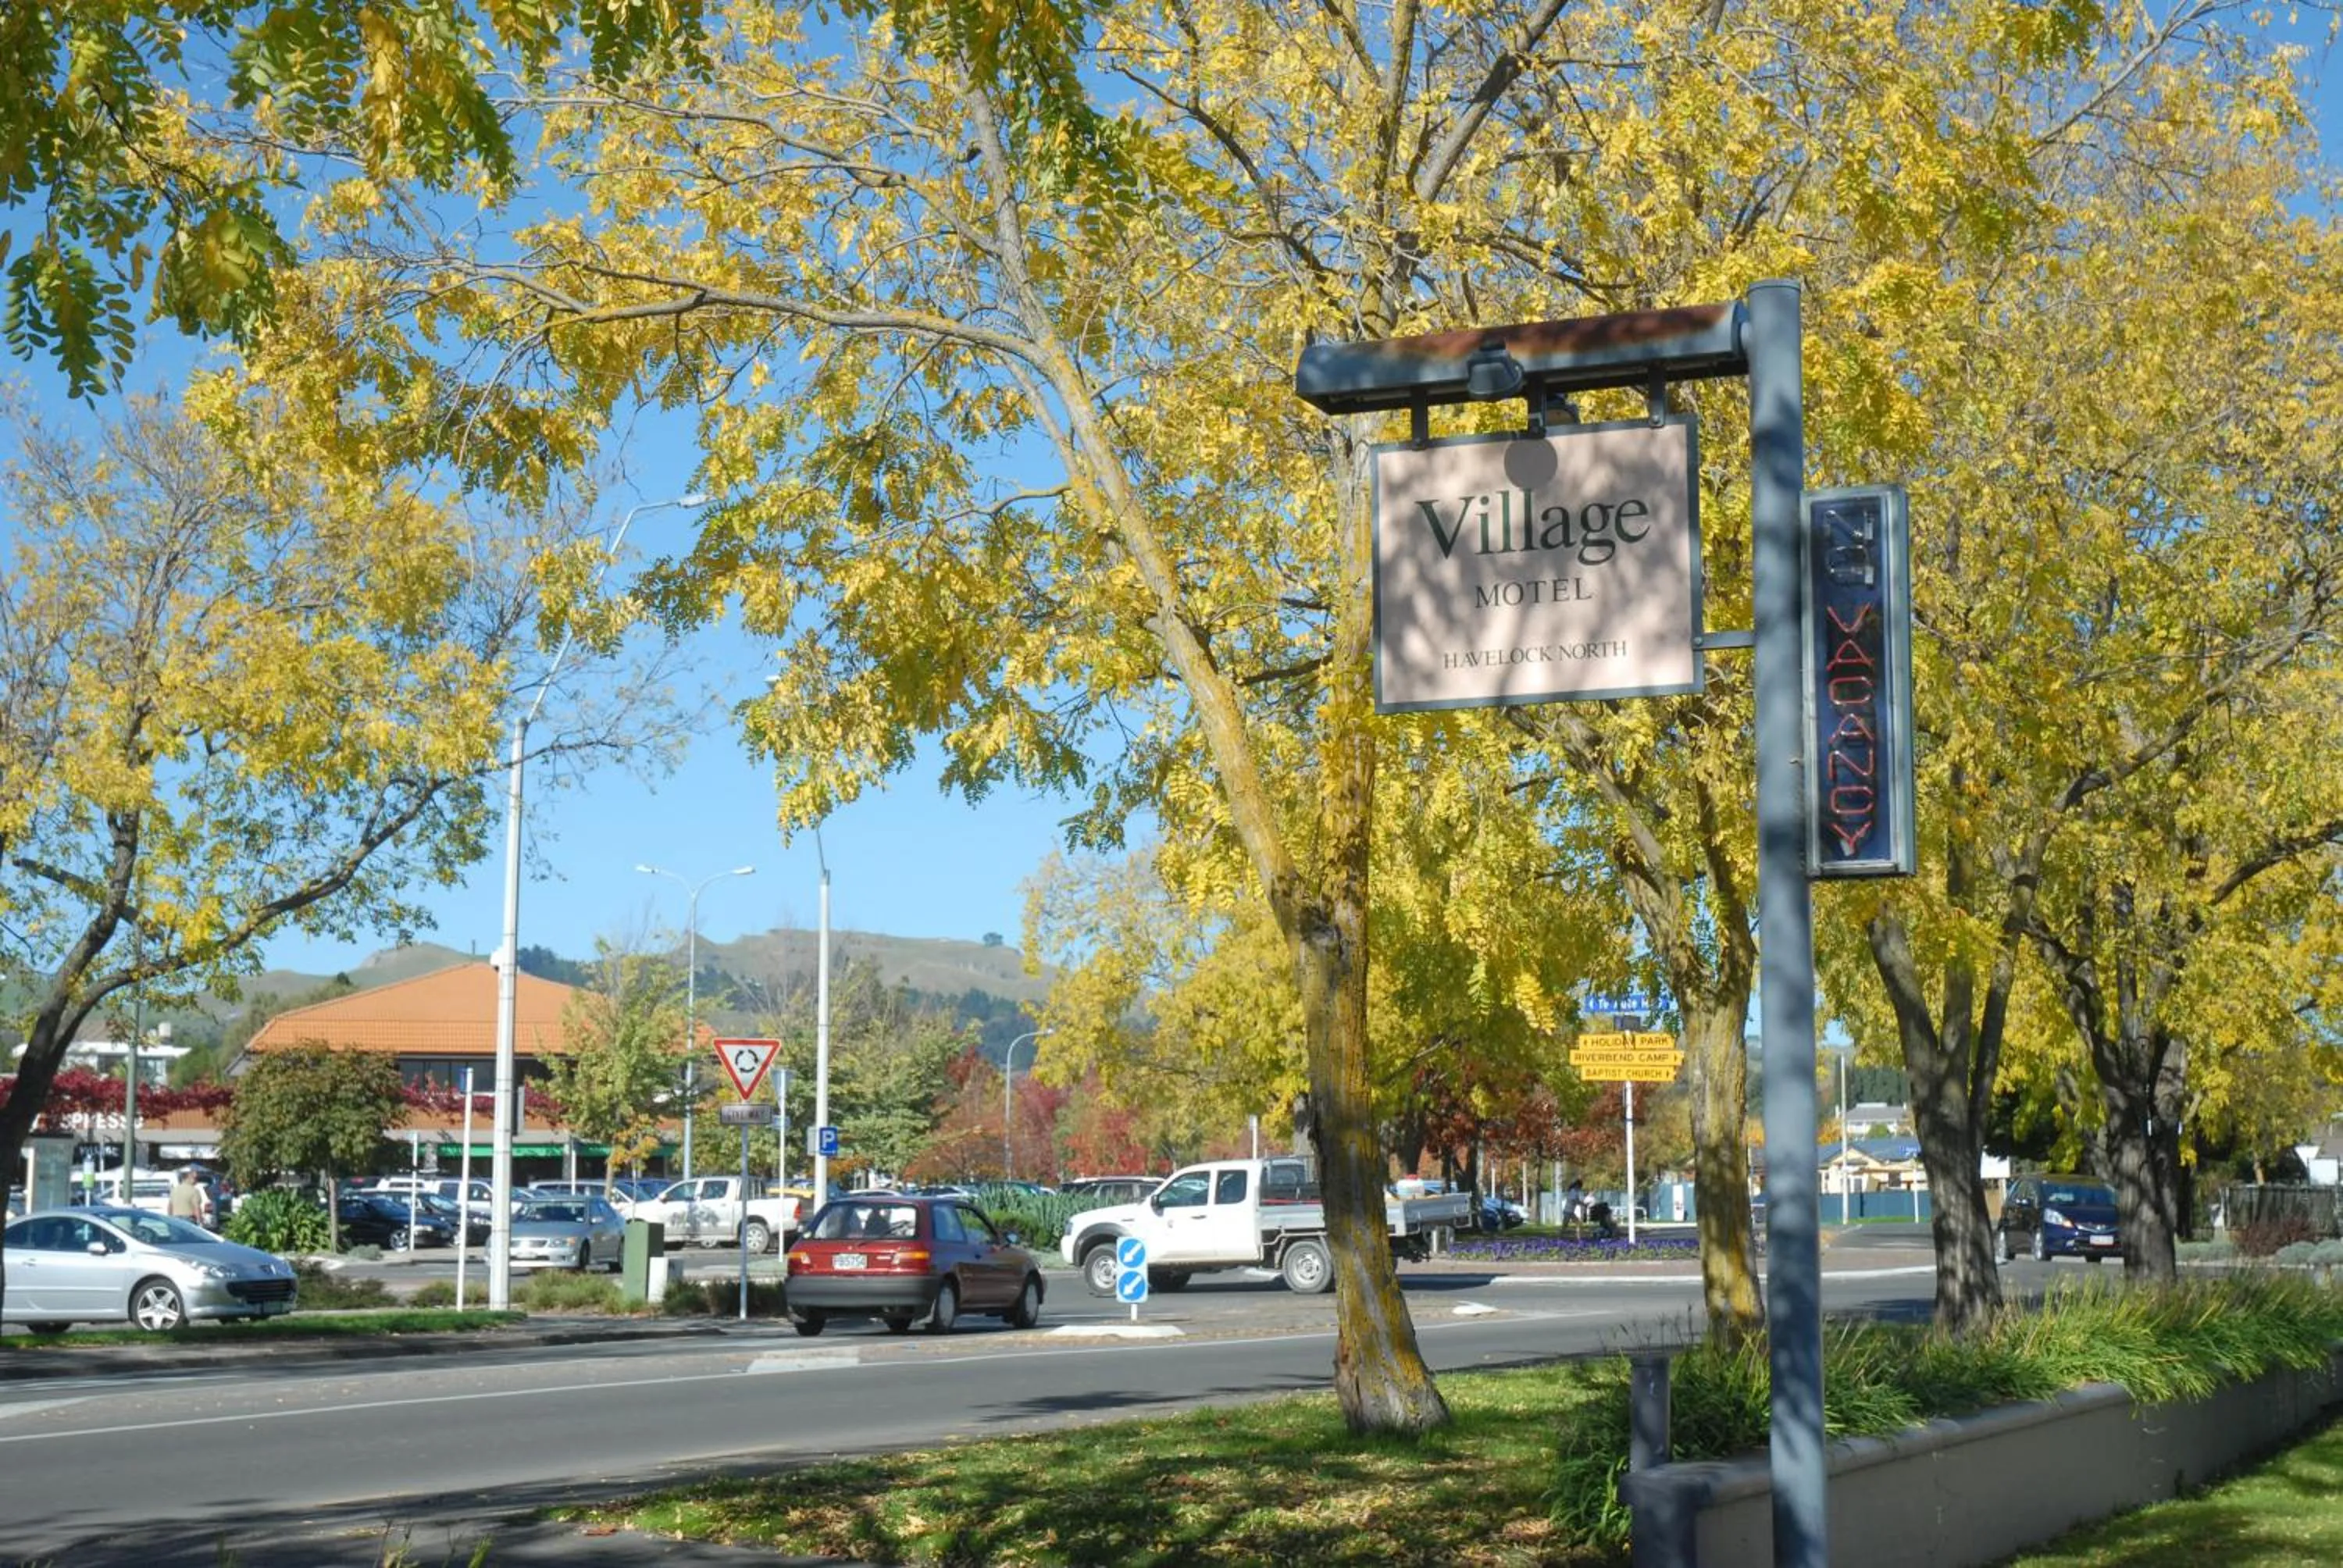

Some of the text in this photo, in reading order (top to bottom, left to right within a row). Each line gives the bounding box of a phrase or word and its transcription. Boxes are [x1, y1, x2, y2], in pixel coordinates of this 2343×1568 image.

[1414, 488, 1650, 566] Village
[1475, 578, 1593, 608] MOTEL
[1444, 640, 1628, 669] HAVELOCK NORTH
[1825, 603, 1875, 856] VACANCY
[1640, 1036, 1668, 1046] PARK
[1574, 1053, 1669, 1063] RIVERBEND CAMP
[1585, 1068, 1662, 1078] BAPTIST CHURCH
[822, 1130, 835, 1149] P
